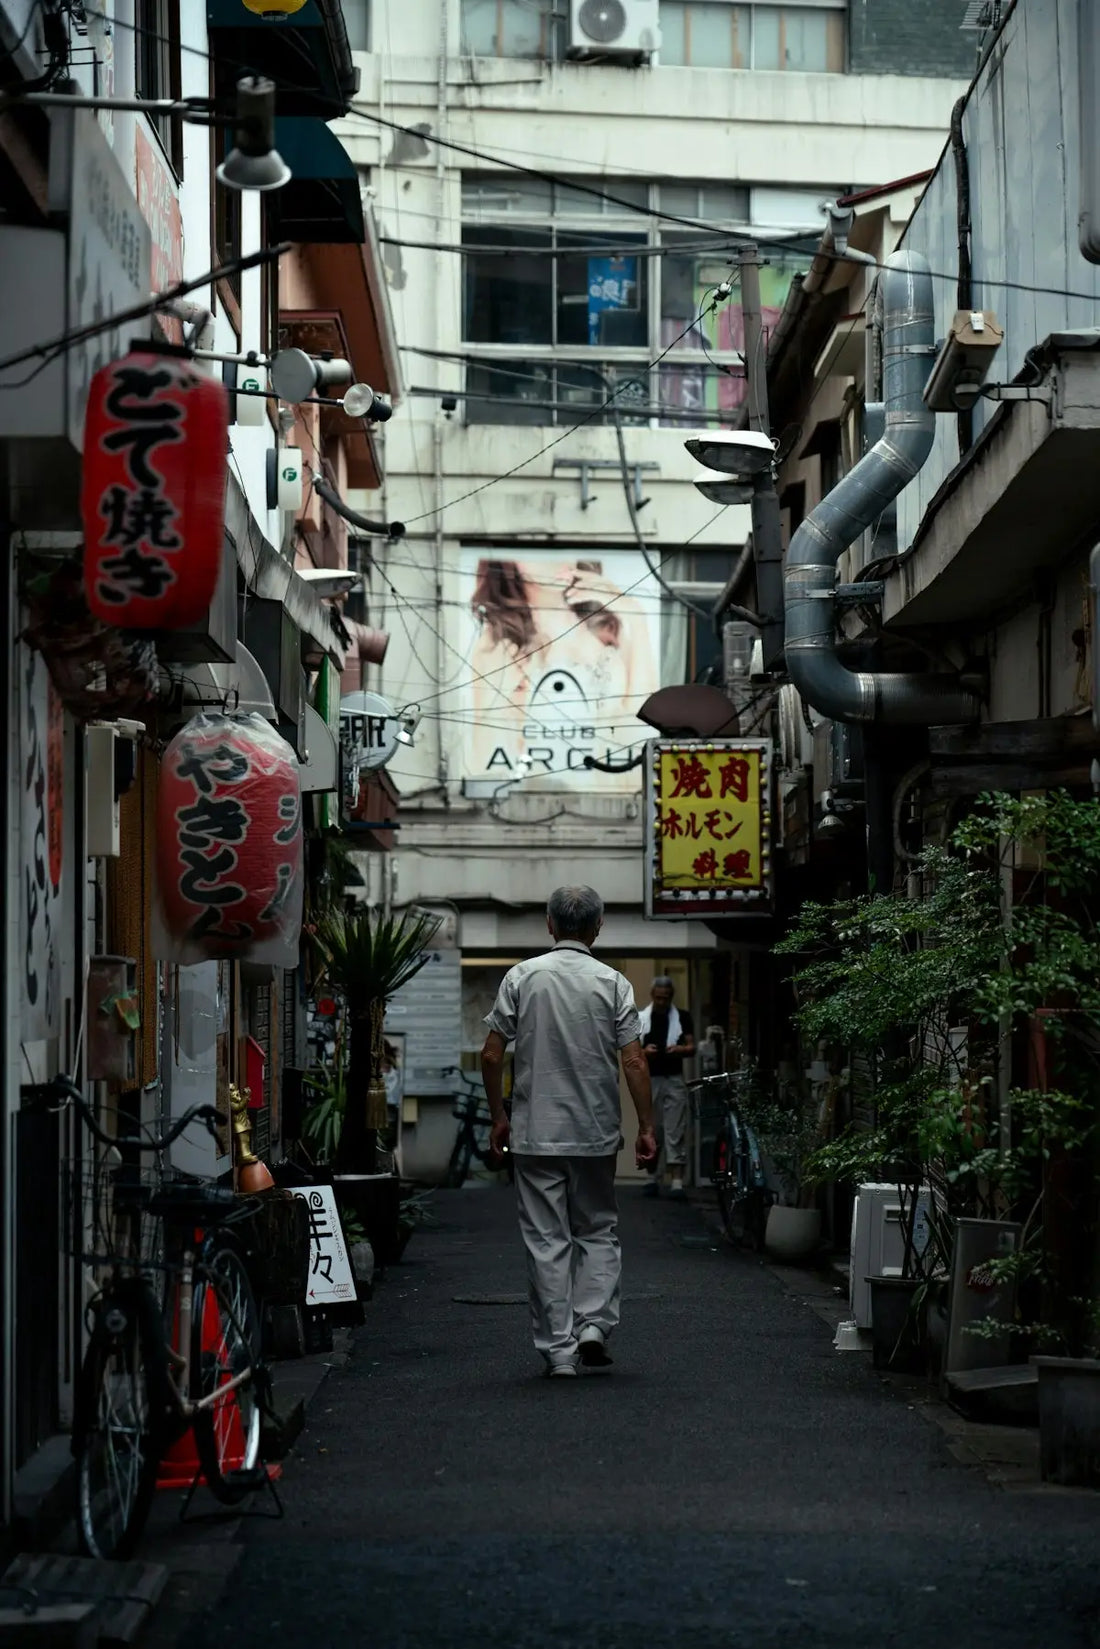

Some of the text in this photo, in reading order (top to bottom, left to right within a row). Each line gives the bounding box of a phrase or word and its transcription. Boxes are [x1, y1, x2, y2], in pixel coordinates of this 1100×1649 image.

[98, 367, 198, 604] どて焼き
[522, 724, 596, 739] CLUB
[668, 756, 749, 803] 焼肉
[175, 740, 253, 942] やきとん
[660, 808, 744, 840] ホルモン
[692, 848, 753, 880] 料理
